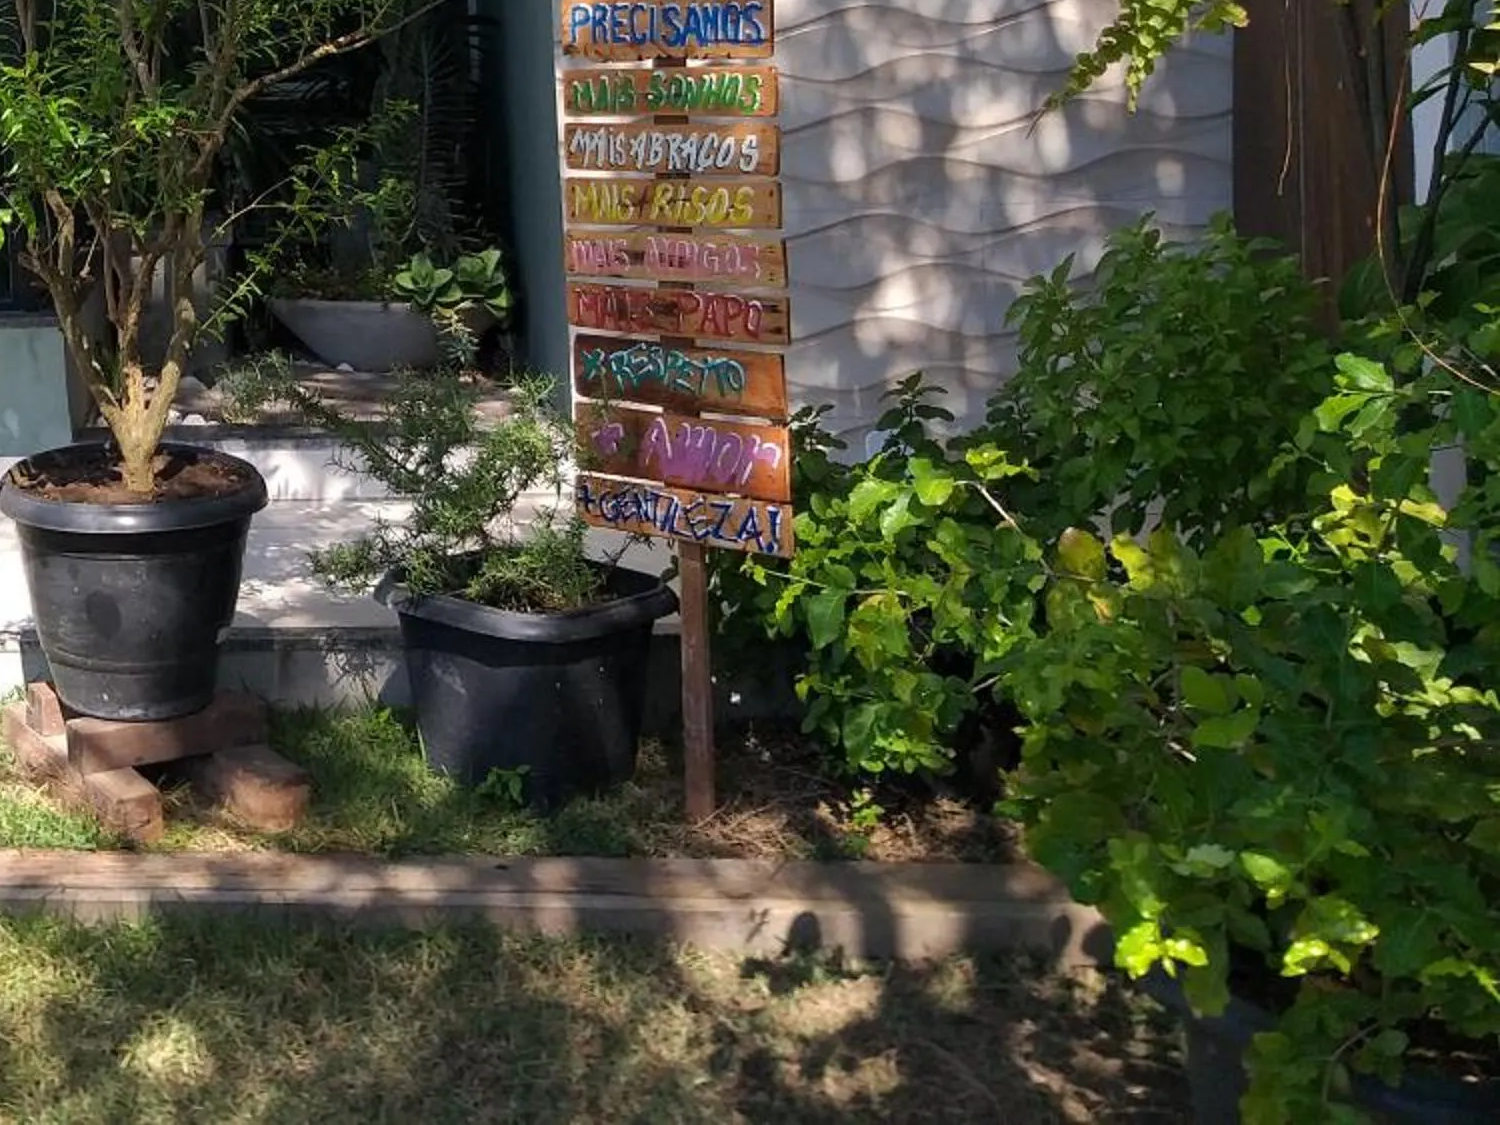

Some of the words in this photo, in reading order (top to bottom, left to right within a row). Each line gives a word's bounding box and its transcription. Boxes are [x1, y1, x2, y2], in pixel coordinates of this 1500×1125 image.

[570, 0, 766, 48] PRECISAMOS
[572, 73, 636, 111] MAIS
[646, 71, 764, 116] SONHOS
[650, 183, 755, 223] RISOS
[571, 238, 630, 272] MAIS
[672, 289, 764, 340] PAPO
